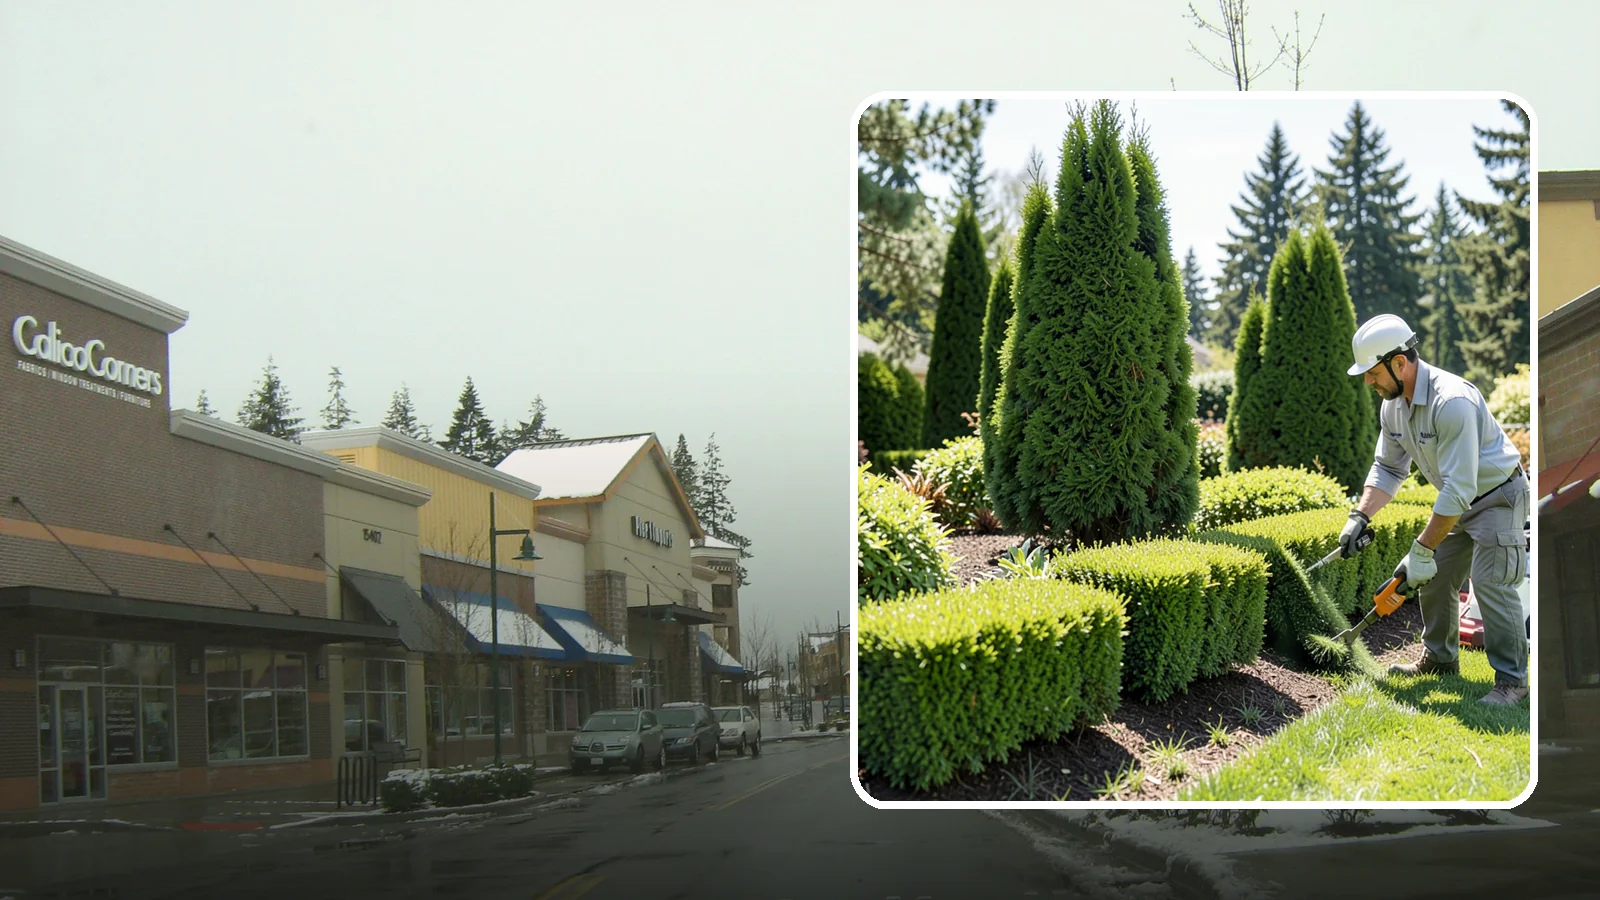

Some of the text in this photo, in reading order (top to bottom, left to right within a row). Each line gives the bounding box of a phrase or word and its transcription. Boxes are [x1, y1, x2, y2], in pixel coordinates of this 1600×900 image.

[16, 360, 151, 408] FABRICS WINDOW TREATMENTS FURNITURE
